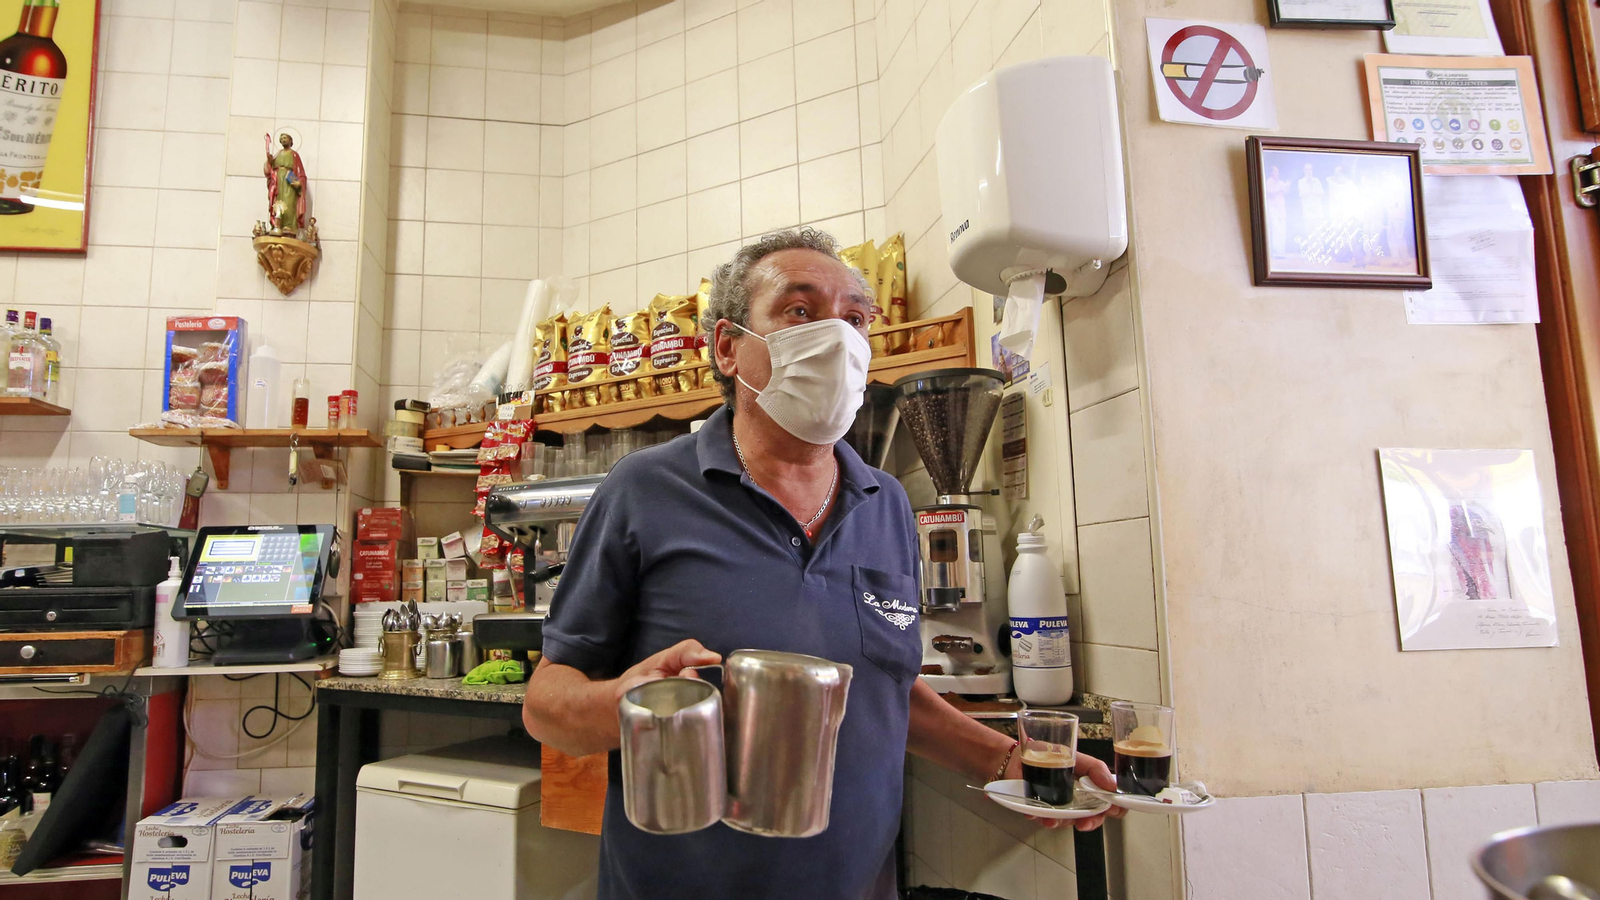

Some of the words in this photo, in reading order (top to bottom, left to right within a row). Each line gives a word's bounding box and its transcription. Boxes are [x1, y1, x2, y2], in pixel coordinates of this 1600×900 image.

[1, 73, 59, 96] ÉRITO
[950, 219, 970, 245] Renova
[661, 377, 672, 386] ORO
[920, 511, 962, 524] CATUNAMBÚ
[863, 591, 881, 607] La
[1039, 620, 1068, 628] PULEVA
[220, 827, 255, 835] Hostelería
